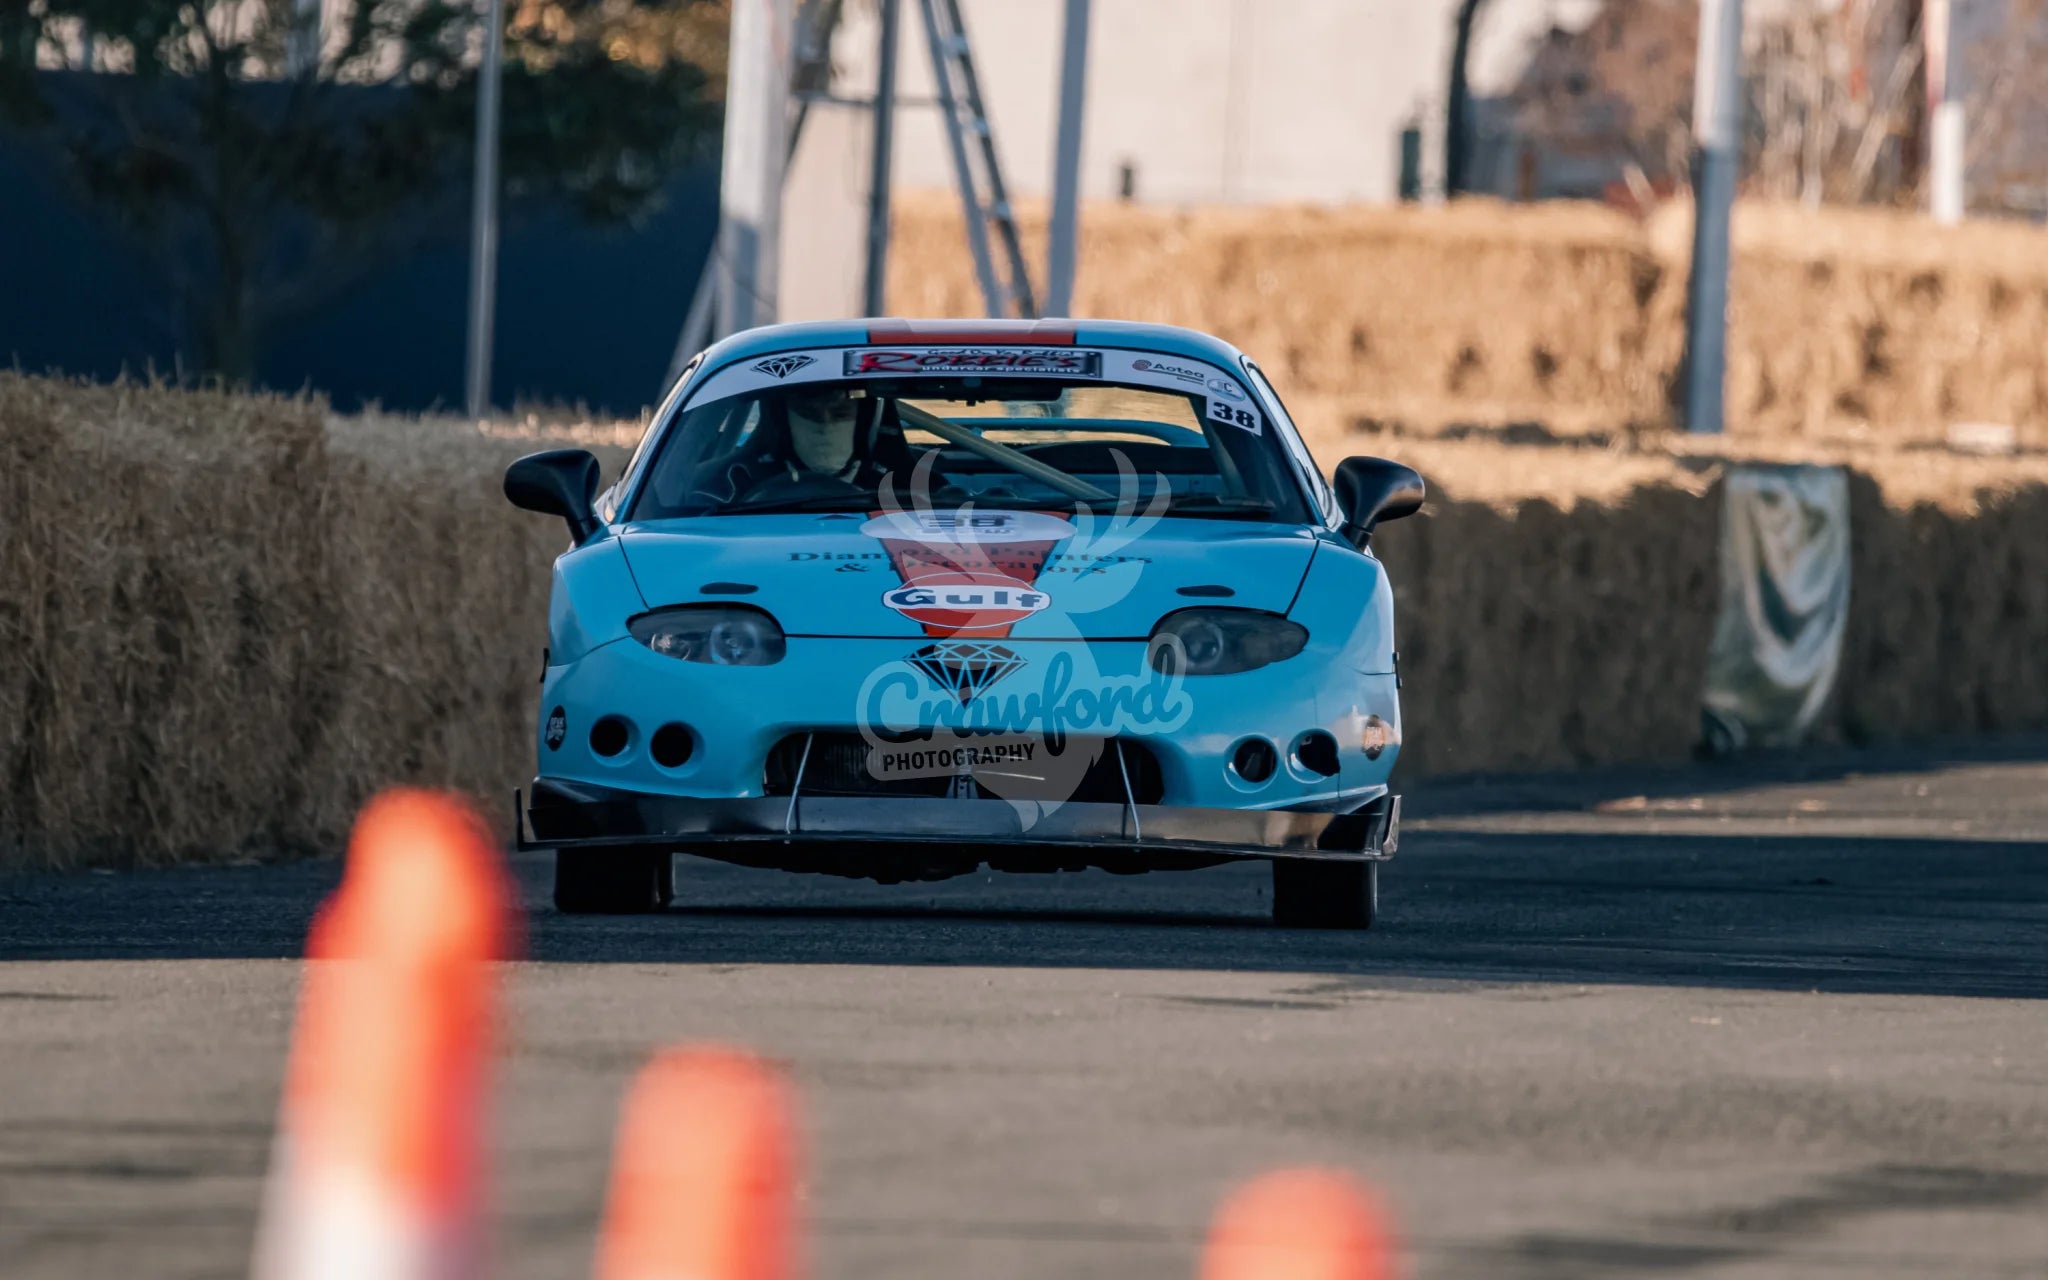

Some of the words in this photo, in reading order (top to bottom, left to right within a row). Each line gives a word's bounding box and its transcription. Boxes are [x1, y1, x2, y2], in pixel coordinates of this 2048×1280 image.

[996, 366, 1080, 374] specialists
[1153, 363, 1205, 379] Aotea
[1212, 401, 1256, 429] 38
[834, 563, 870, 573] &
[890, 588, 1043, 608] Gulf
